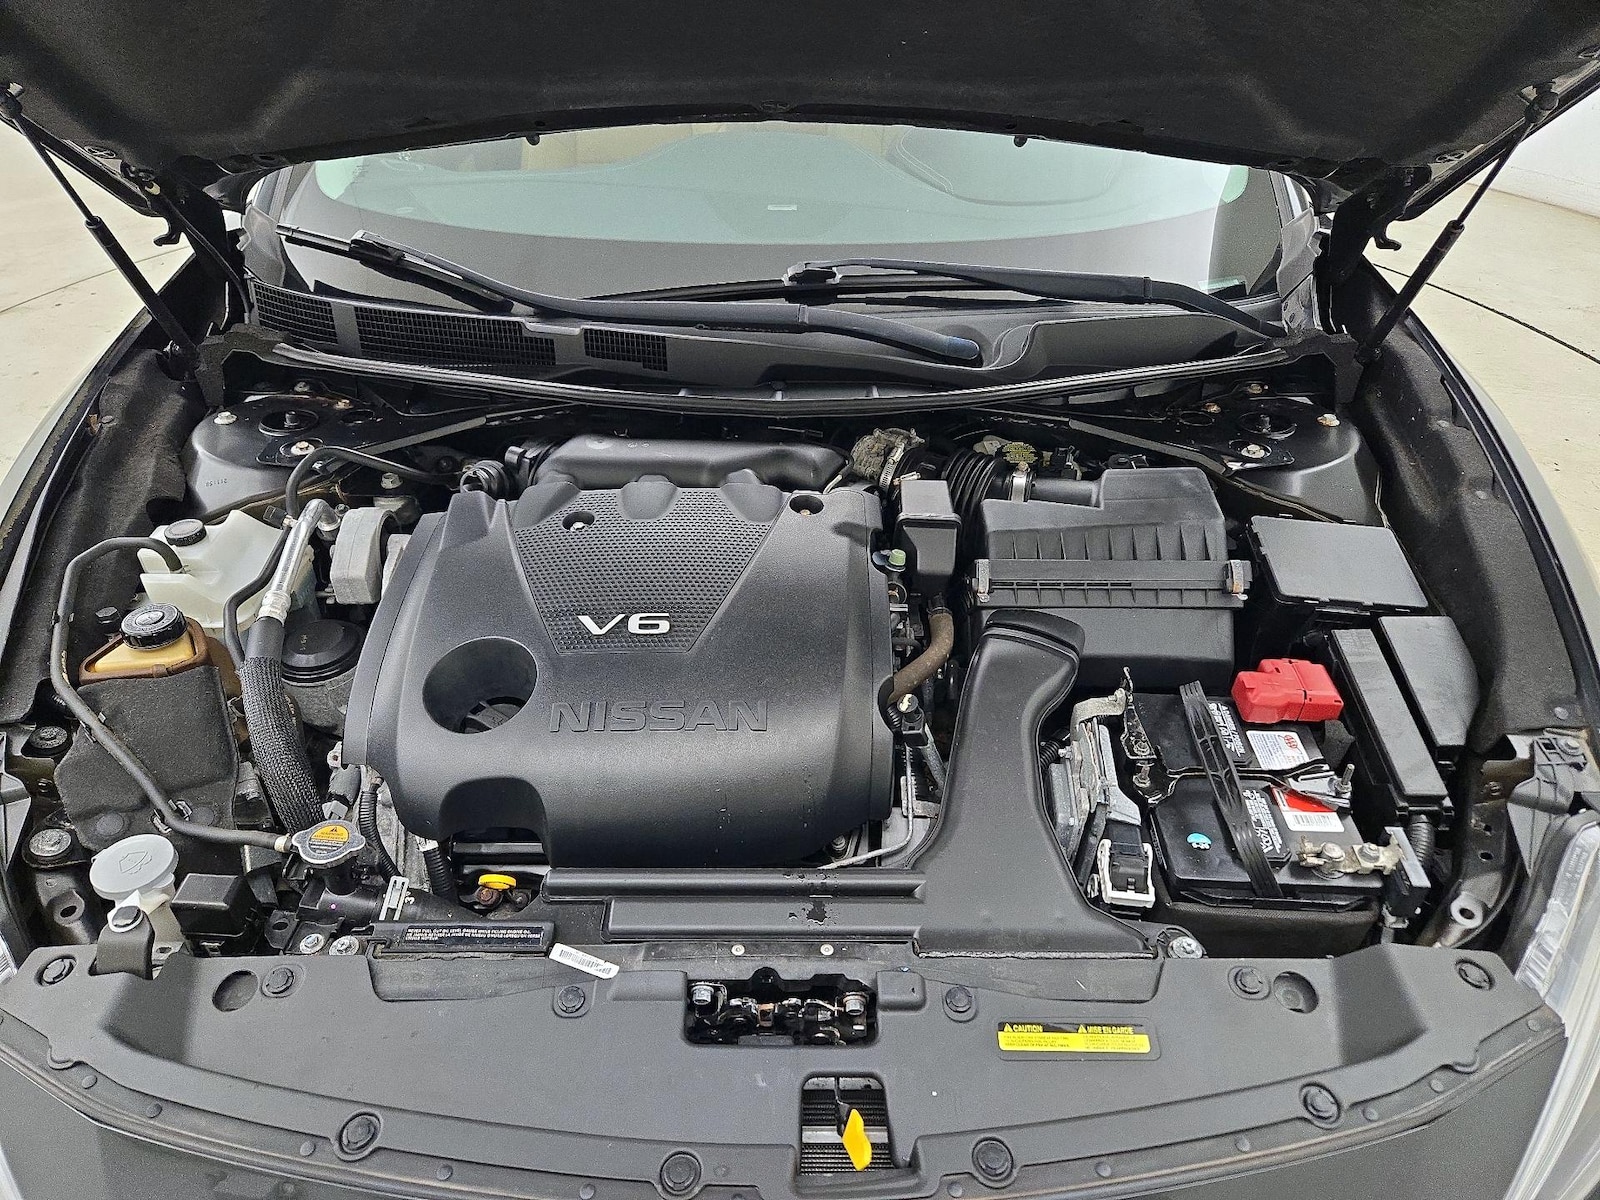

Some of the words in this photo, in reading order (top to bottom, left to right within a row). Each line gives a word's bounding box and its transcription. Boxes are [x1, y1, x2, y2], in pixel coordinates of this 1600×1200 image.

[577, 612, 671, 636] V6
[549, 700, 768, 733] NISSAN
[1012, 1024, 1044, 1032] CAUTION
